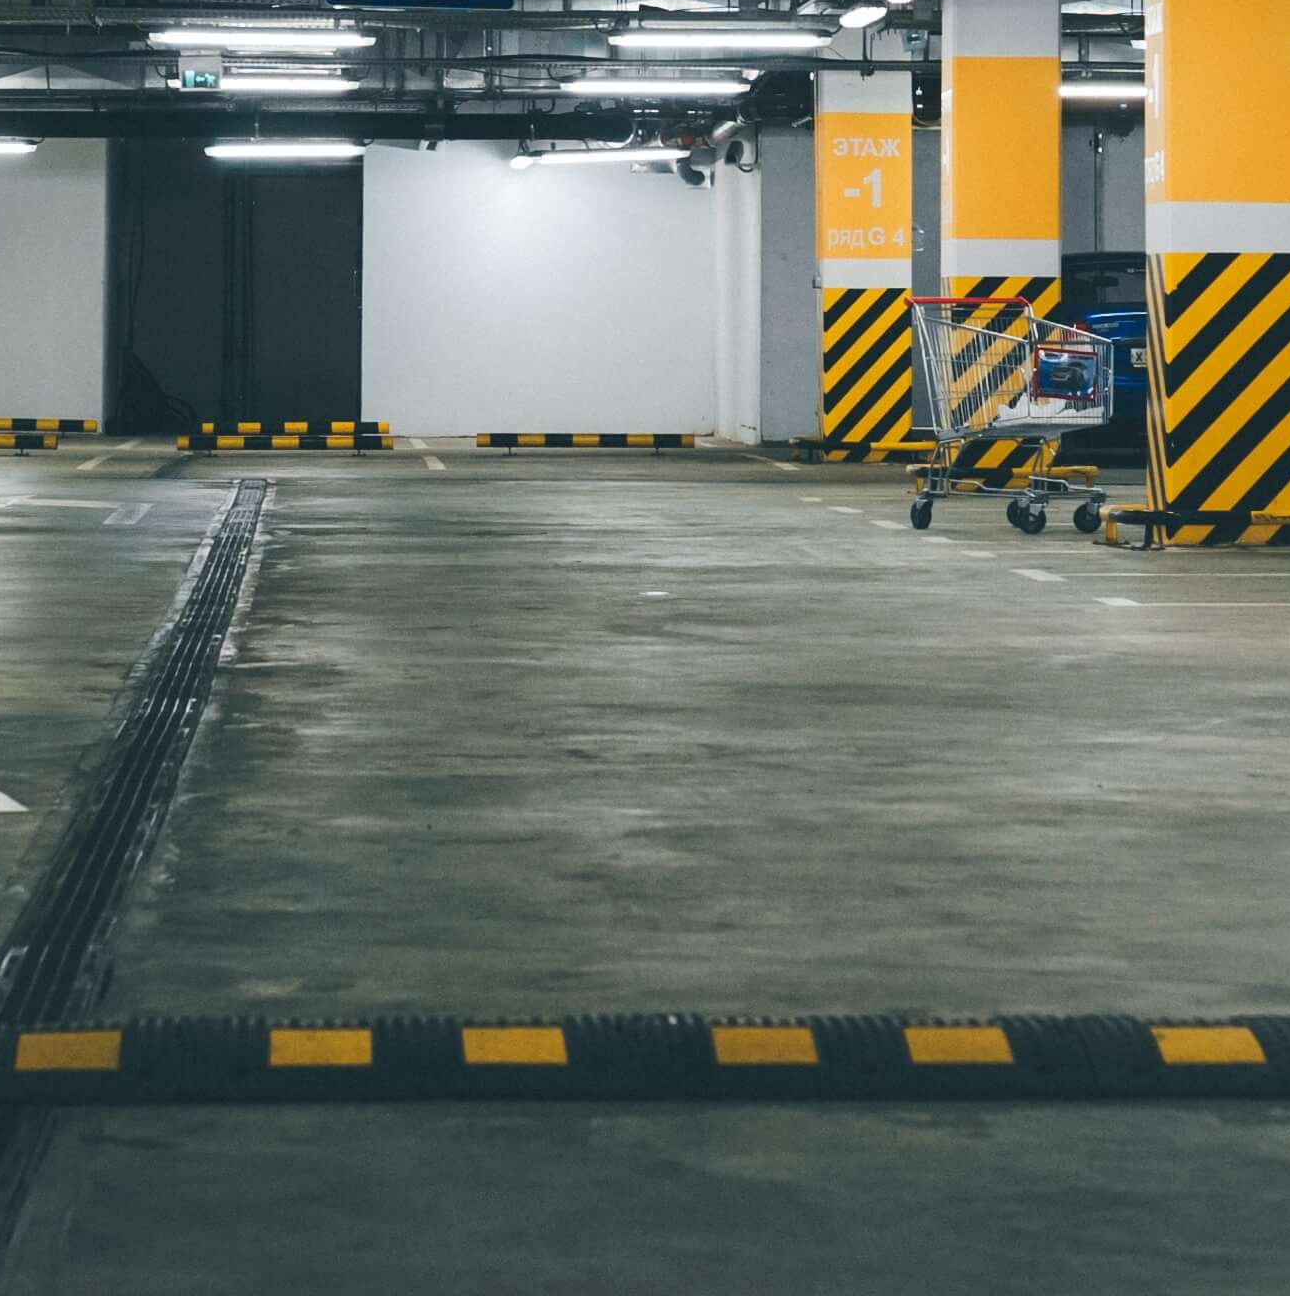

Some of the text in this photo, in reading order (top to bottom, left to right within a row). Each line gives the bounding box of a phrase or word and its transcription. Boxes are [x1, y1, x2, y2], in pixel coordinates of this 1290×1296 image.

[832, 137, 902, 158] ЭТАЖ
[843, 167, 883, 209] -1
[891, 226, 907, 246] 4
